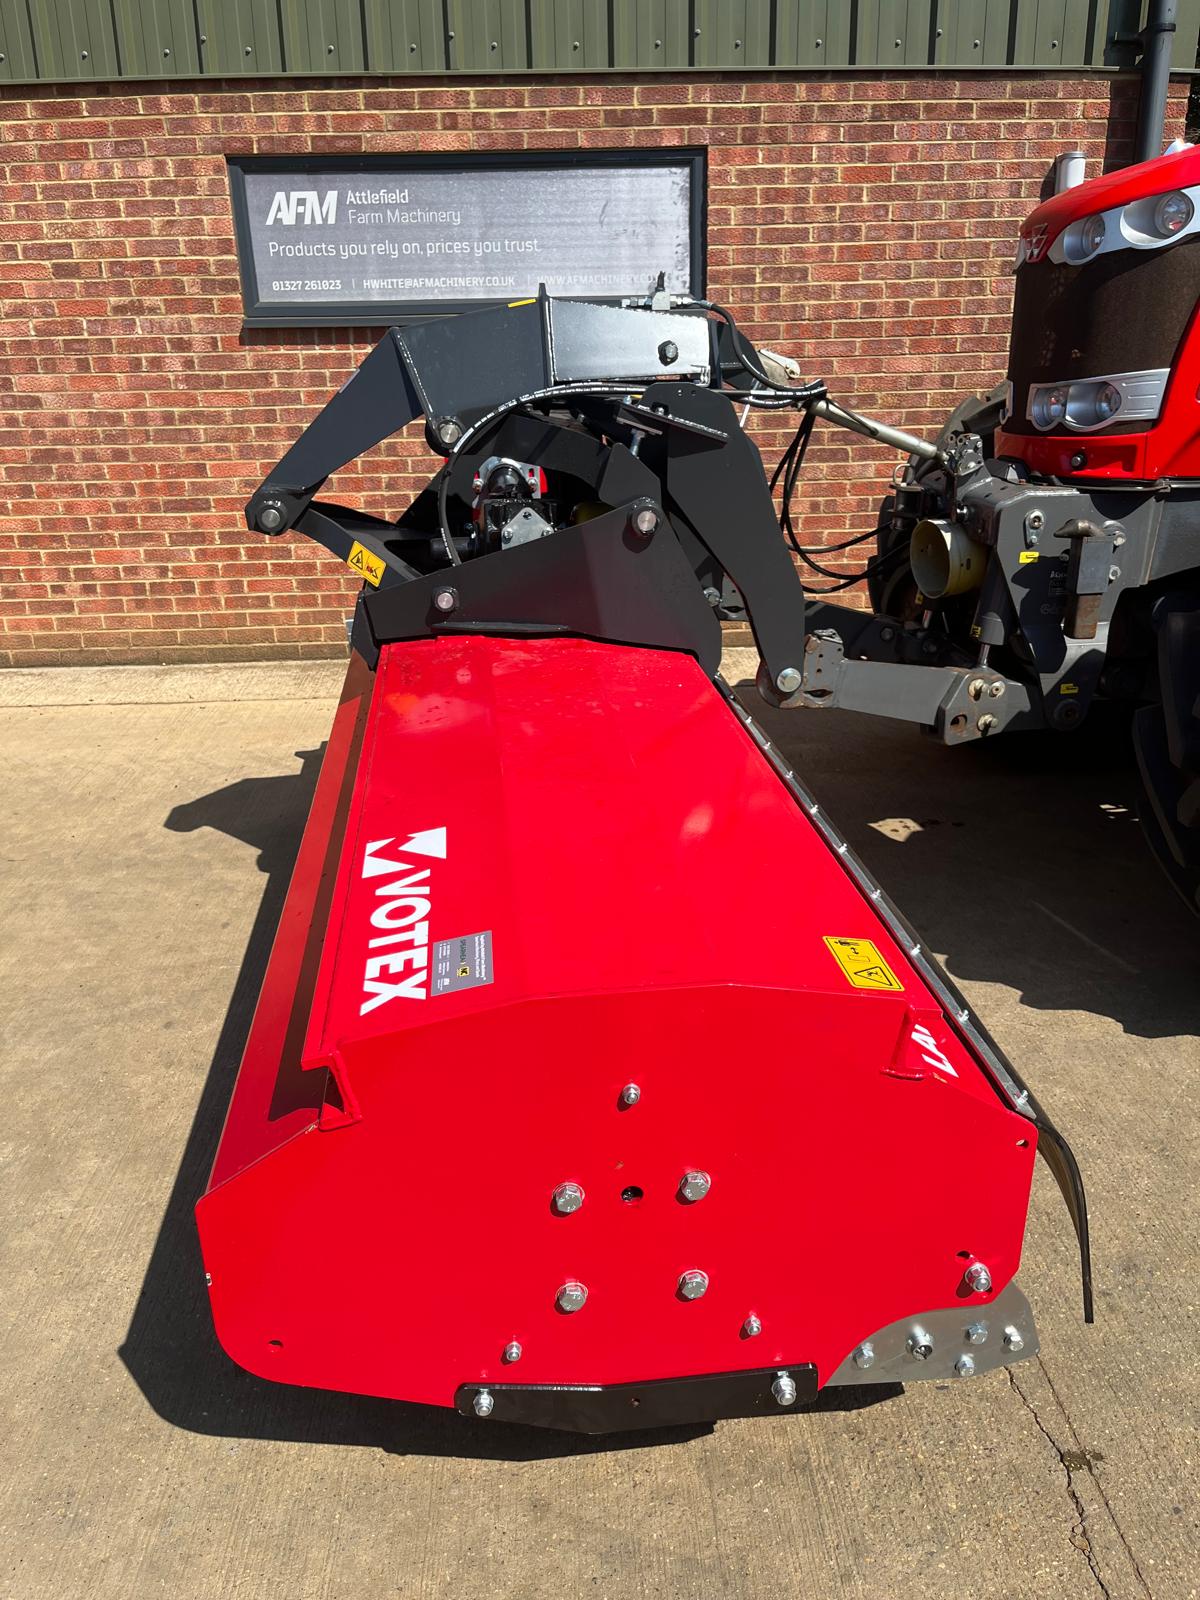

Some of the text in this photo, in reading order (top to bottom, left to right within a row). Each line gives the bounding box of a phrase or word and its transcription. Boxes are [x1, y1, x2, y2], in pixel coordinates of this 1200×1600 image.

[346, 189, 409, 204] Attlefield
[265, 190, 339, 225] AFM
[348, 207, 462, 226] Farm Machinery
[270, 241, 336, 257] Products
[340, 243, 367, 259] you
[371, 240, 399, 258] rely
[426, 240, 471, 257] prices
[474, 241, 502, 257] you
[504, 239, 541, 253] trust
[272, 281, 302, 291] 01327
[304, 280, 342, 291] 261023
[363, 277, 515, 290] HWHITE@AFMACHINERY.CO.UK
[360, 868, 432, 1016] VOTEX
